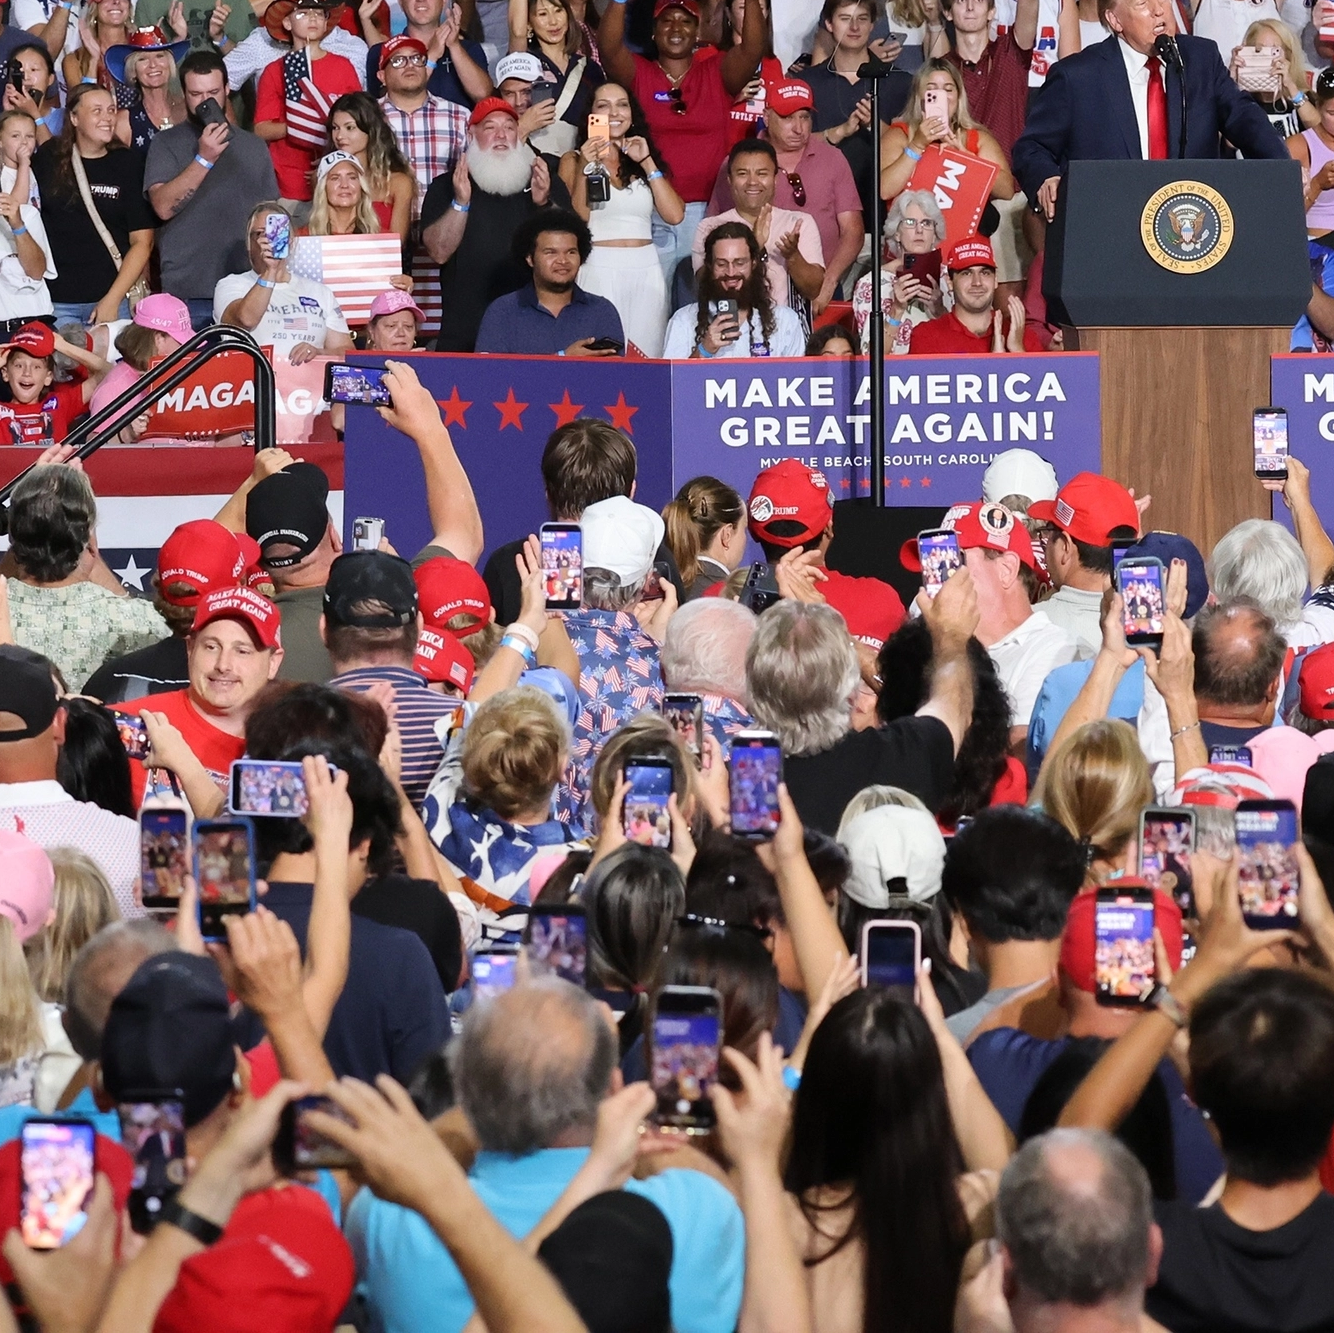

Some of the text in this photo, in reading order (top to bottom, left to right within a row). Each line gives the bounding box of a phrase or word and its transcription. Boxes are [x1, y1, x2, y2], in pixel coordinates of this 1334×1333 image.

[324, 151, 355, 165] USA
[90, 185, 118, 195] TRUMP
[1145, 184, 1184, 226] PRESIDENT
[1210, 195, 1230, 233] UNITED
[1156, 249, 1180, 269] SEAL
[1195, 239, 1227, 269] STATES
[156, 380, 255, 414] MAGA
[705, 376, 835, 409] MAKE
[720, 410, 1053, 447] GREAT AGAIN!
[883, 453, 932, 466] SOUTH
[937, 451, 999, 465] CAROLI
[185, 569, 209, 584] TRUMP
[206, 587, 273, 614] MAKE AMERICA
[208, 599, 268, 622] GREAT AGAIN
[433, 599, 485, 618] DONALD TRUMP
